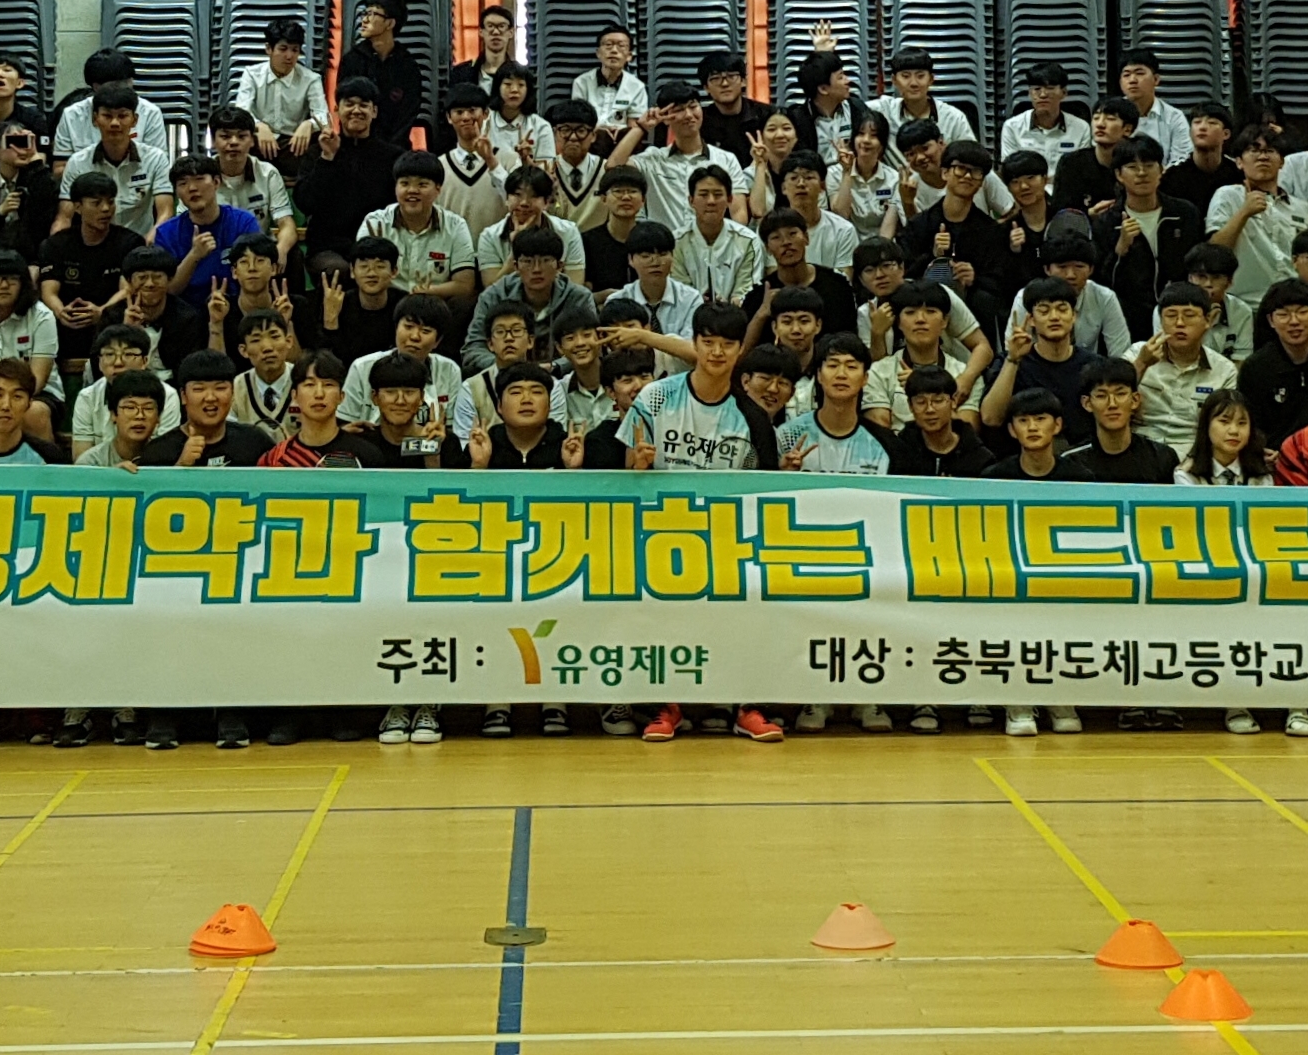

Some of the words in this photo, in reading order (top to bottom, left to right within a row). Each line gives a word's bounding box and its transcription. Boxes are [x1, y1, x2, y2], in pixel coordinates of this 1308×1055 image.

[662, 428, 739, 469] 유영제약
[407, 493, 867, 598] 함께하는
[376, 636, 457, 684] 주최
[551, 643, 709, 687] 유영제약
[808, 637, 892, 684] 대상
